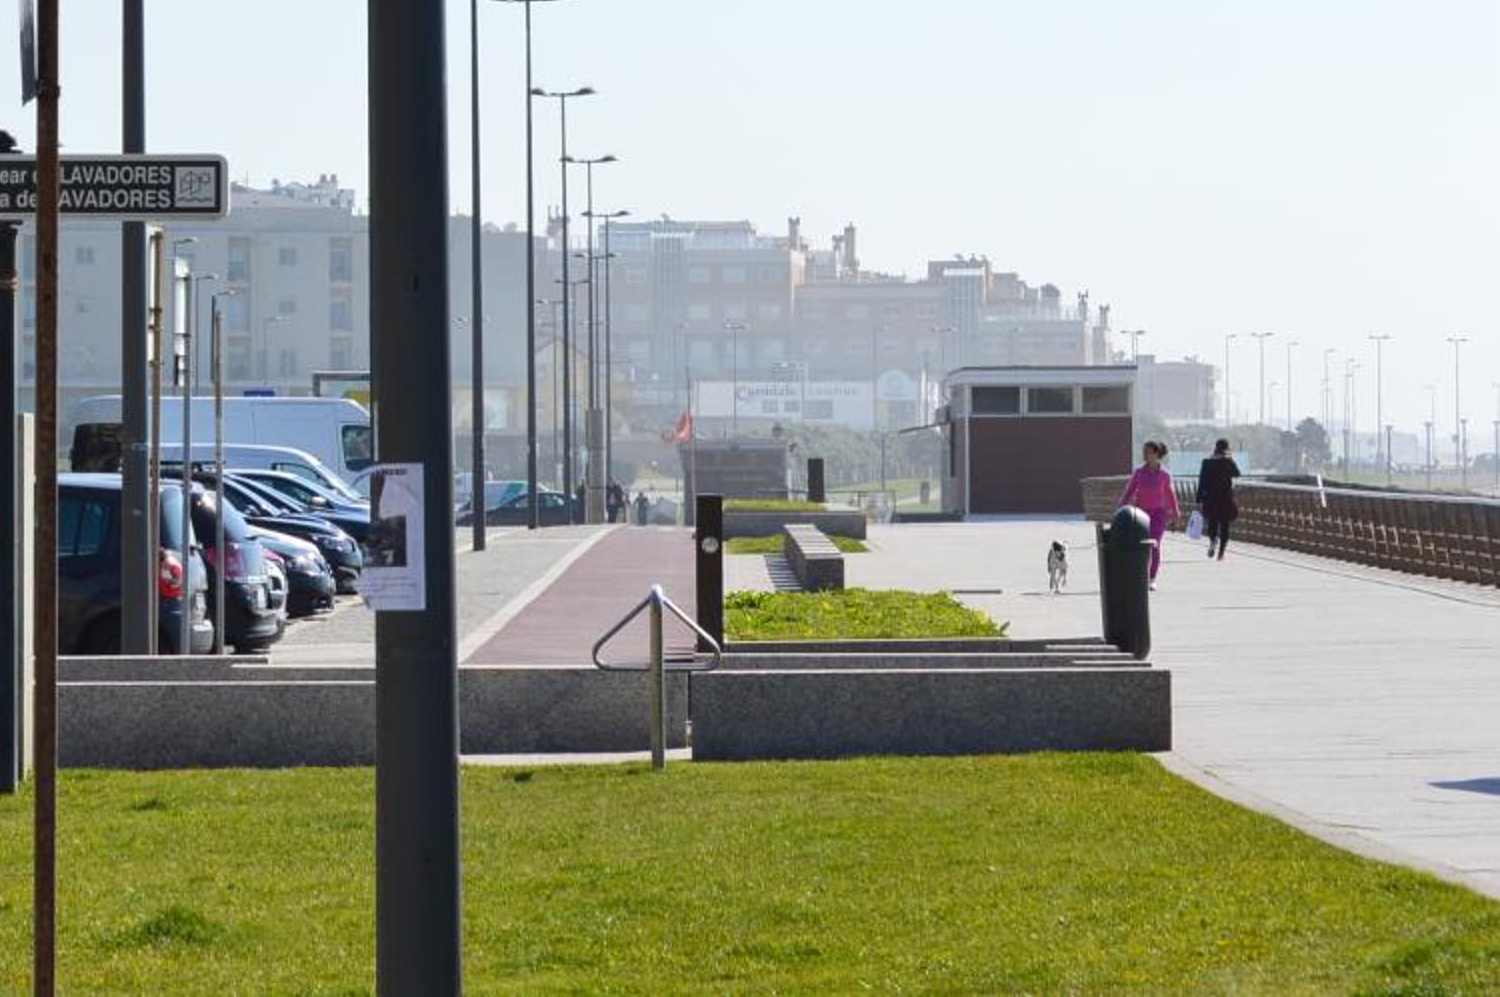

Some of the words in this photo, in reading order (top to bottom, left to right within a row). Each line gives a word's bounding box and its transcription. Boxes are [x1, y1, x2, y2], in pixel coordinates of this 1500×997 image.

[60, 166, 171, 184] LAVADORES
[16, 190, 37, 208] de
[58, 190, 171, 208] AVADORES
